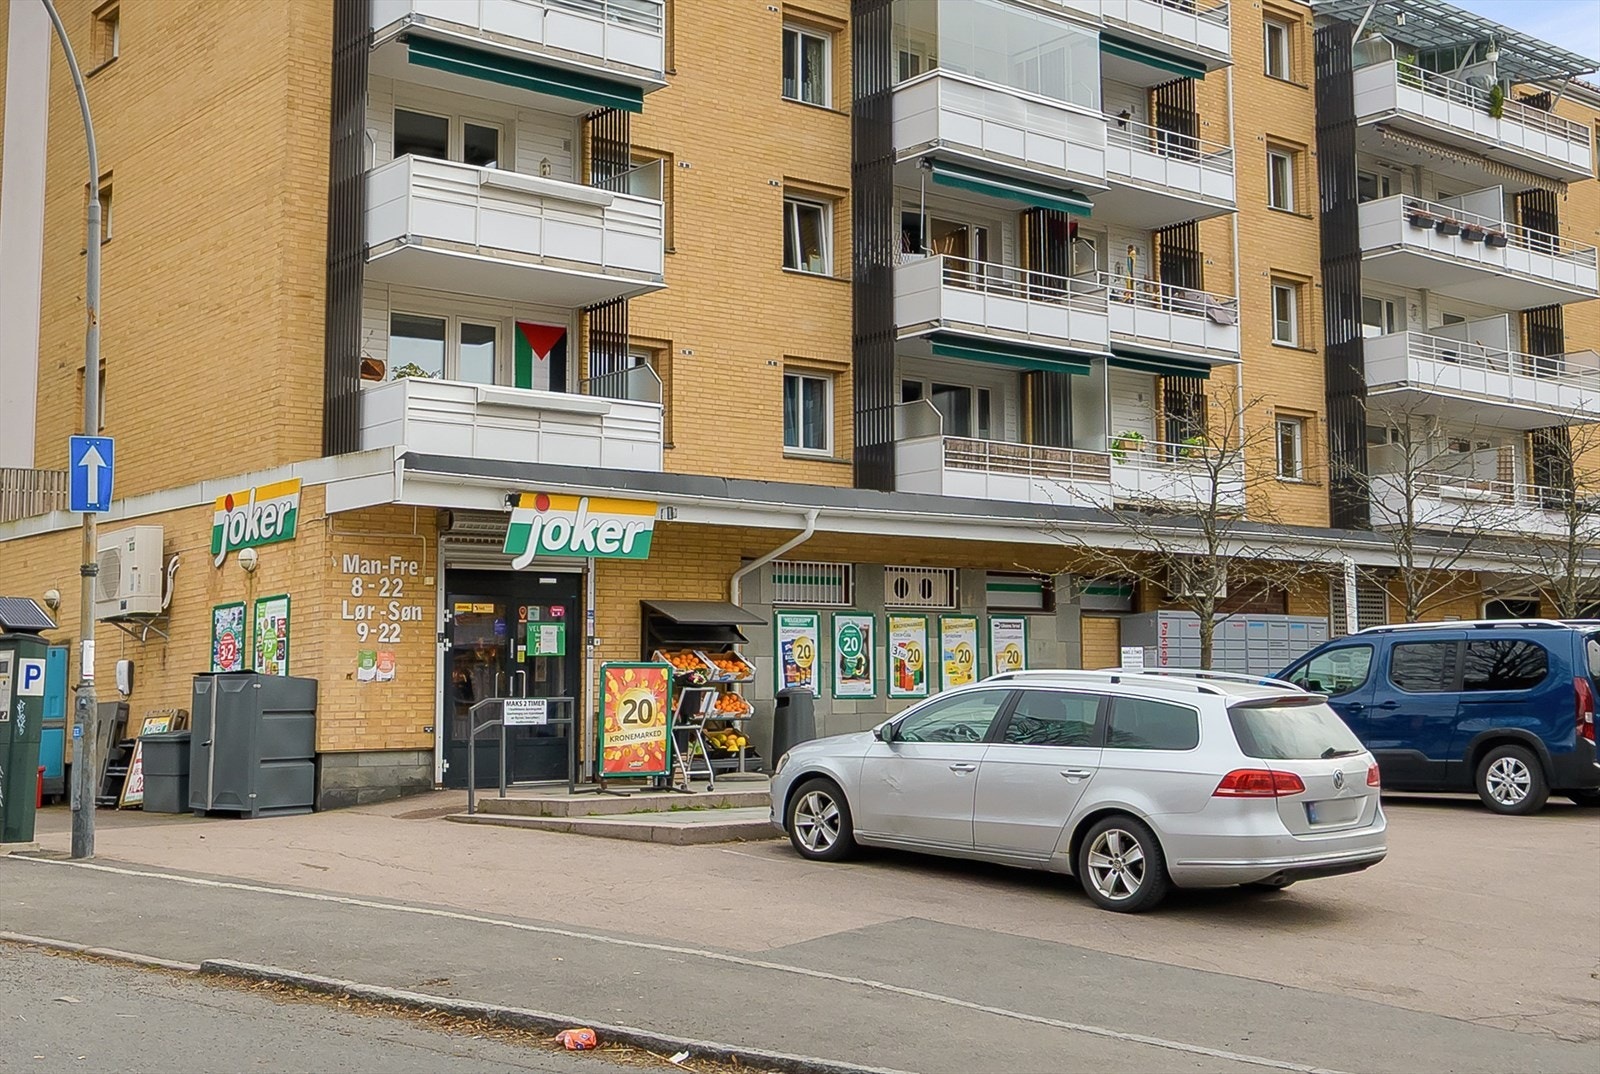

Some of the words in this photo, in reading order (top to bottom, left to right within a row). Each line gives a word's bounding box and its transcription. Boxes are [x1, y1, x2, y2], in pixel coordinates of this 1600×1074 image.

[214, 487, 292, 567] joker
[511, 494, 645, 570] joker
[342, 554, 418, 576] Man-Fre
[796, 644, 811, 659] 20
[843, 637, 858, 652] 20
[892, 646, 898, 655] 3
[907, 648, 920, 663] 20
[958, 649, 971, 664] 20
[1006, 650, 1019, 664] 20
[24, 664, 41, 689] P
[622, 698, 652, 725] 20
[609, 730, 662, 743] KRONEMARKED
